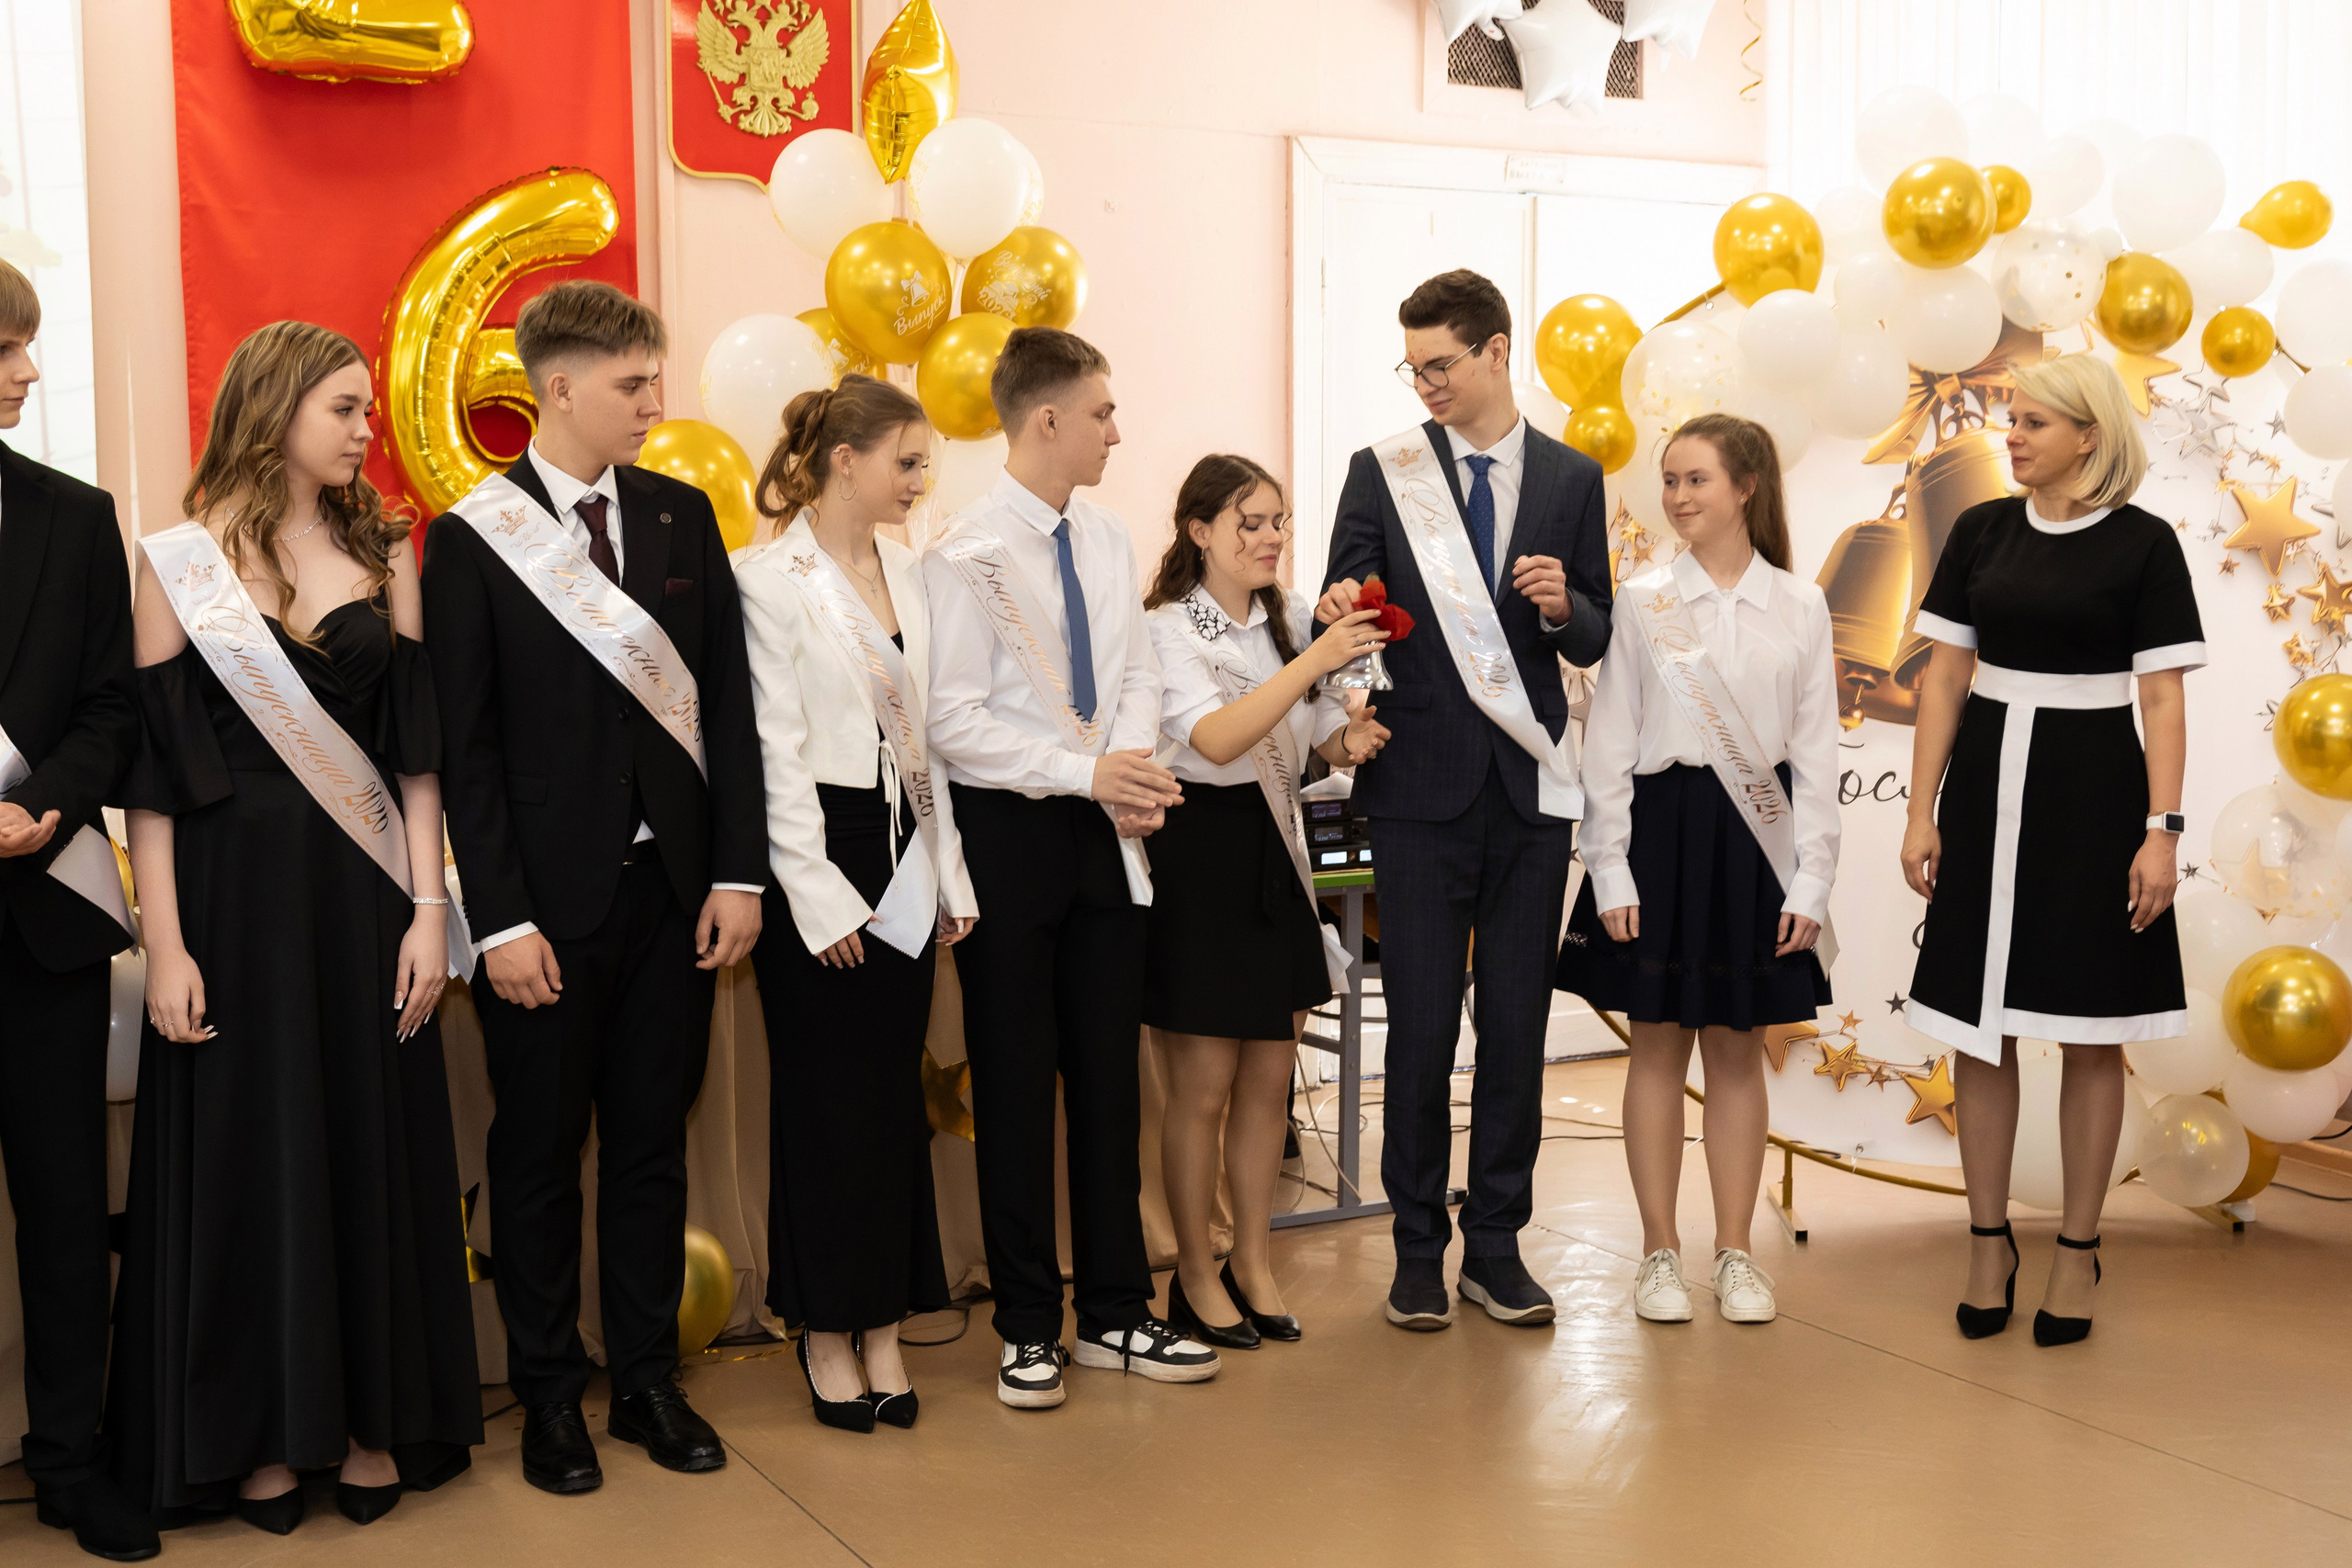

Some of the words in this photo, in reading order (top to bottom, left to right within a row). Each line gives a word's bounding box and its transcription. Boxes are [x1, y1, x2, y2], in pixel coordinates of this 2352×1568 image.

[893, 284, 947, 336] Выпуск!
[198, 605, 356, 788] Выпускница
[338, 781, 392, 835] 2026
[819, 589, 922, 761] Выпускница
[910, 767, 935, 818] 2026
[1467, 651, 1525, 698] 2026
[1654, 625, 1755, 776] Выпускница
[1741, 779, 1788, 824] 2026
